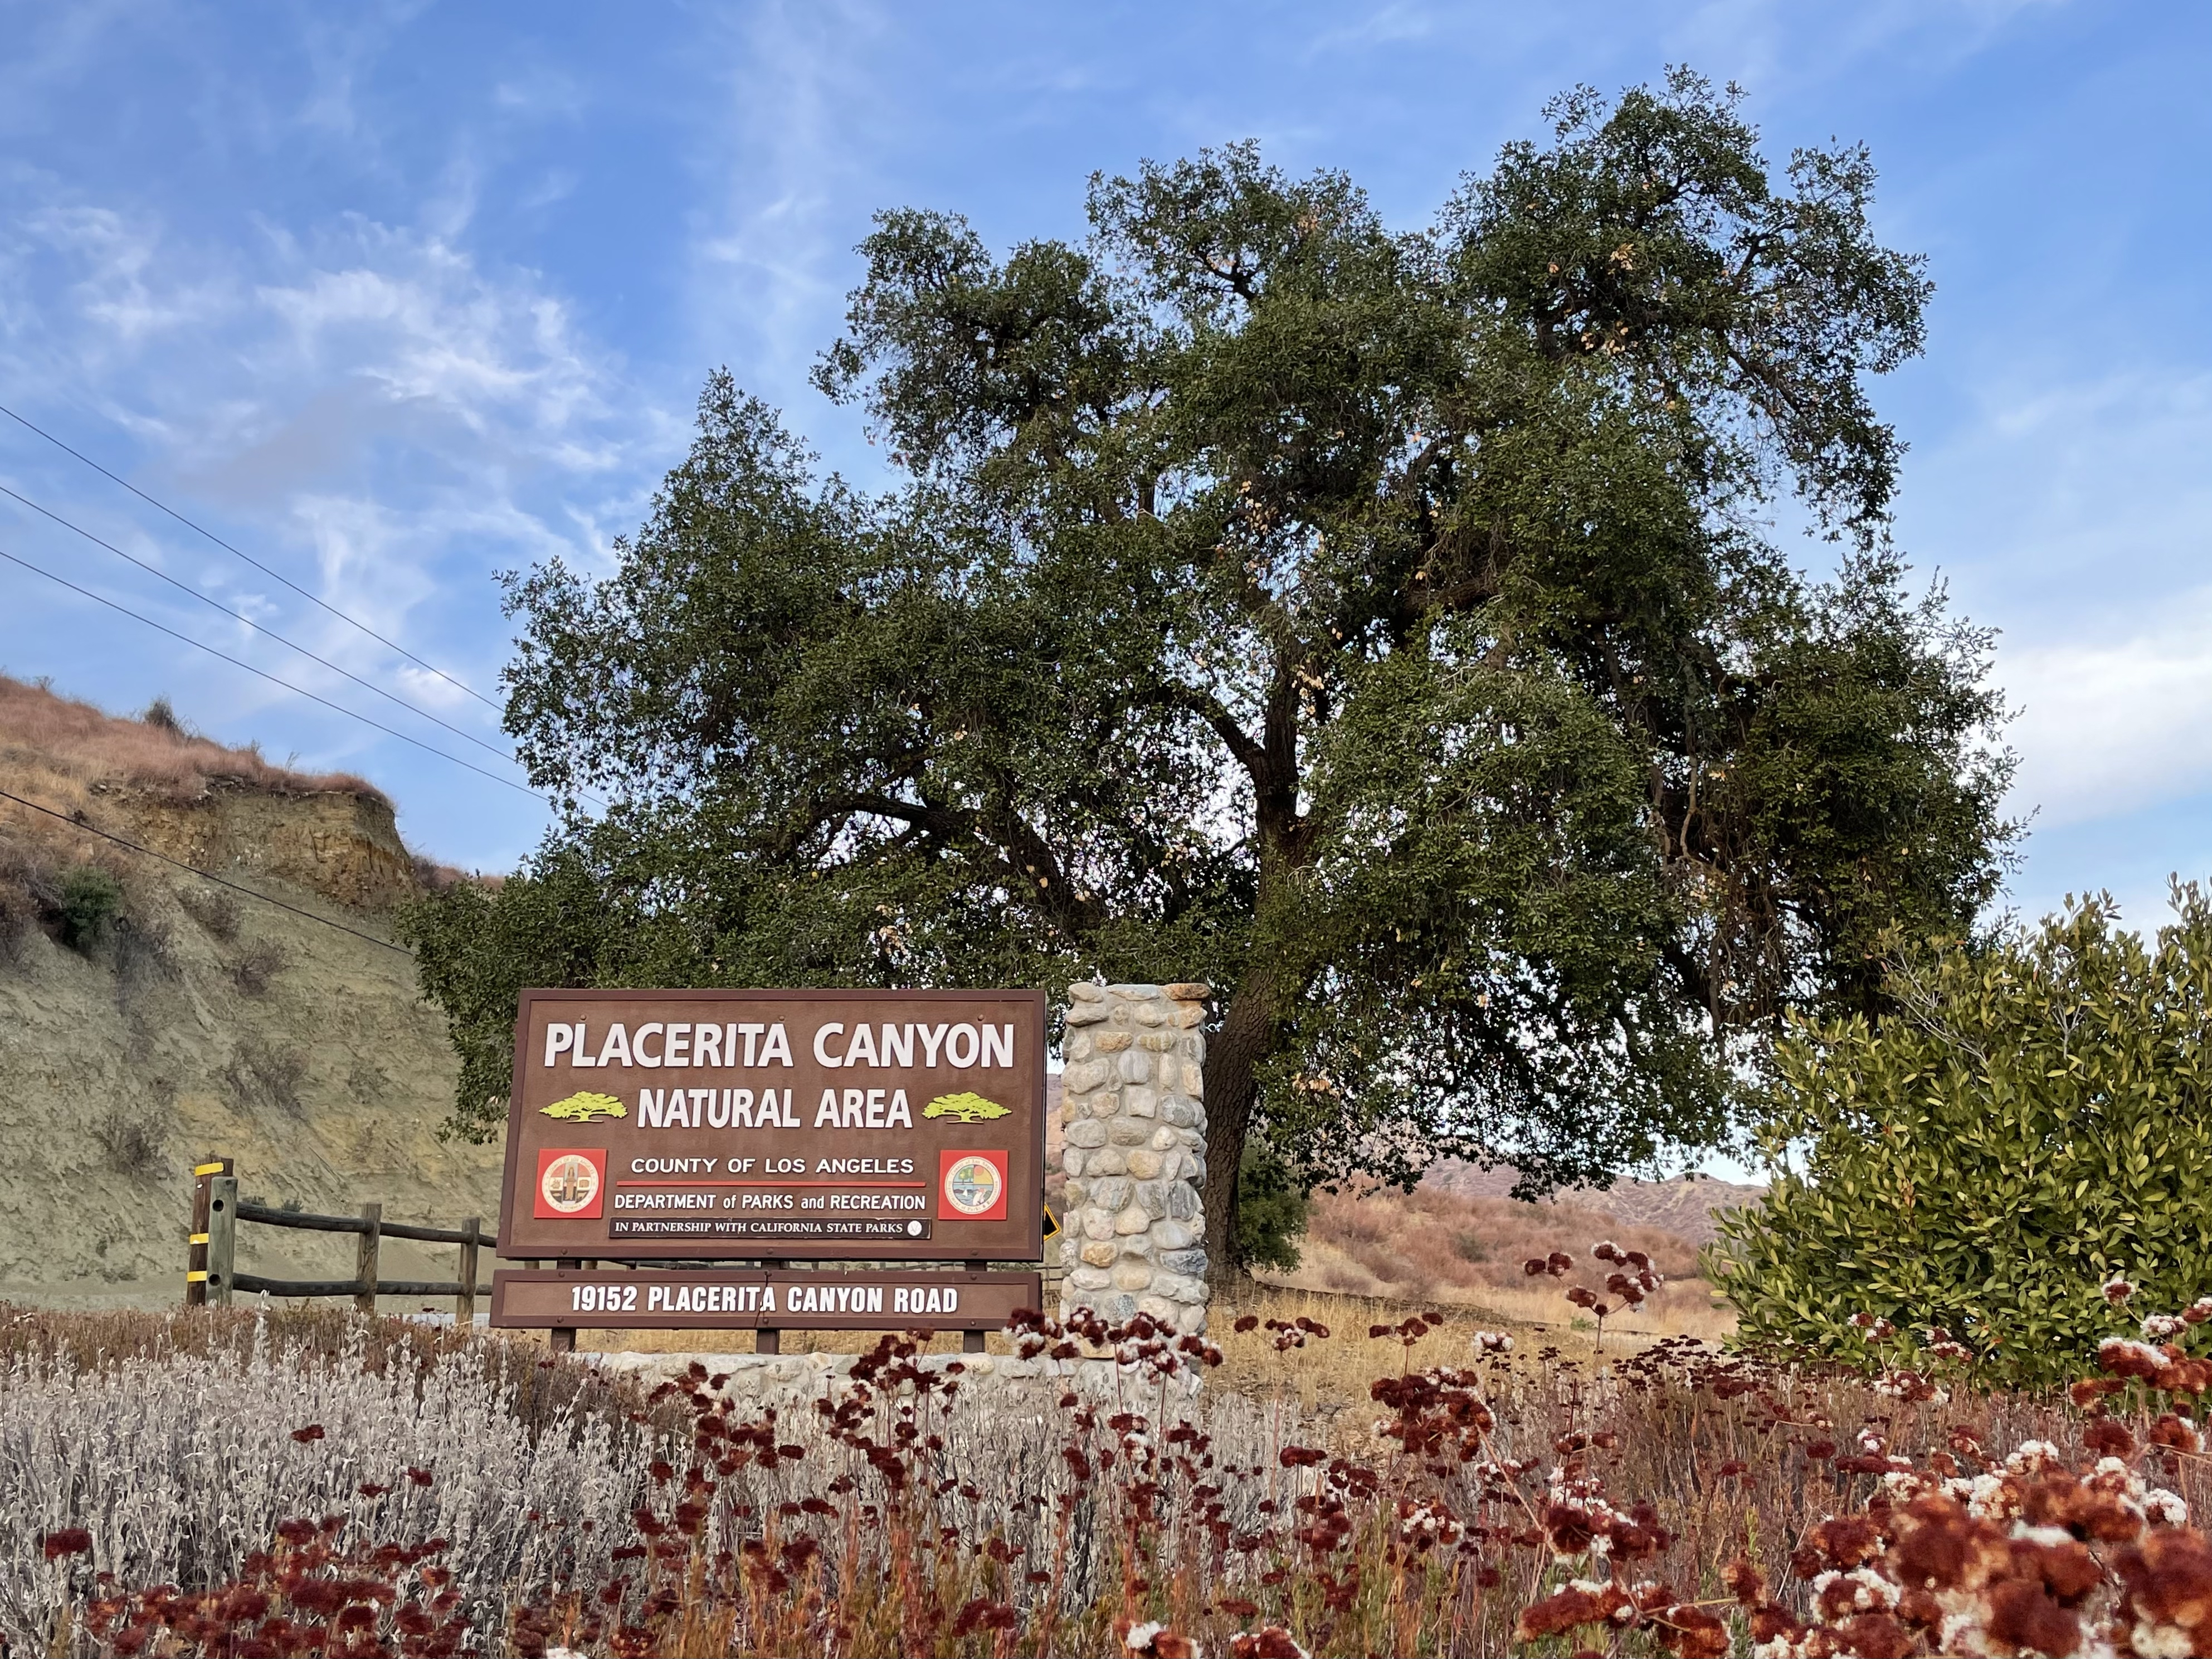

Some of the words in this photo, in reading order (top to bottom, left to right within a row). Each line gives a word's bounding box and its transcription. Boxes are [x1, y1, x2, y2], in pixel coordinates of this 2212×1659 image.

[544, 1023, 793, 1068] PLACERITA
[813, 1023, 1014, 1068] CANYON
[637, 1088, 801, 1128] NATURAL
[813, 1089, 913, 1128] AREA
[631, 1158, 718, 1173] COUNTY
[728, 1158, 756, 1173] OF
[765, 1158, 806, 1173] LOS
[815, 1159, 914, 1174] ANGELES
[615, 1194, 717, 1209] DEPARTMENT
[723, 1194, 737, 1209] of
[742, 1194, 793, 1209] PARKS
[801, 1195, 825, 1209] and
[830, 1195, 925, 1210] RECREATION
[615, 1222, 629, 1232] IN
[632, 1222, 712, 1232] PARTNERSHIP
[715, 1223, 747, 1232] WITH
[751, 1223, 822, 1232] CALIFORNIA
[826, 1223, 862, 1233] STATE
[865, 1223, 903, 1233] PARKS
[572, 1285, 637, 1311] 19152
[647, 1286, 776, 1312] PLACERITA
[787, 1286, 883, 1312] CANYON
[894, 1288, 957, 1313] ROAD
